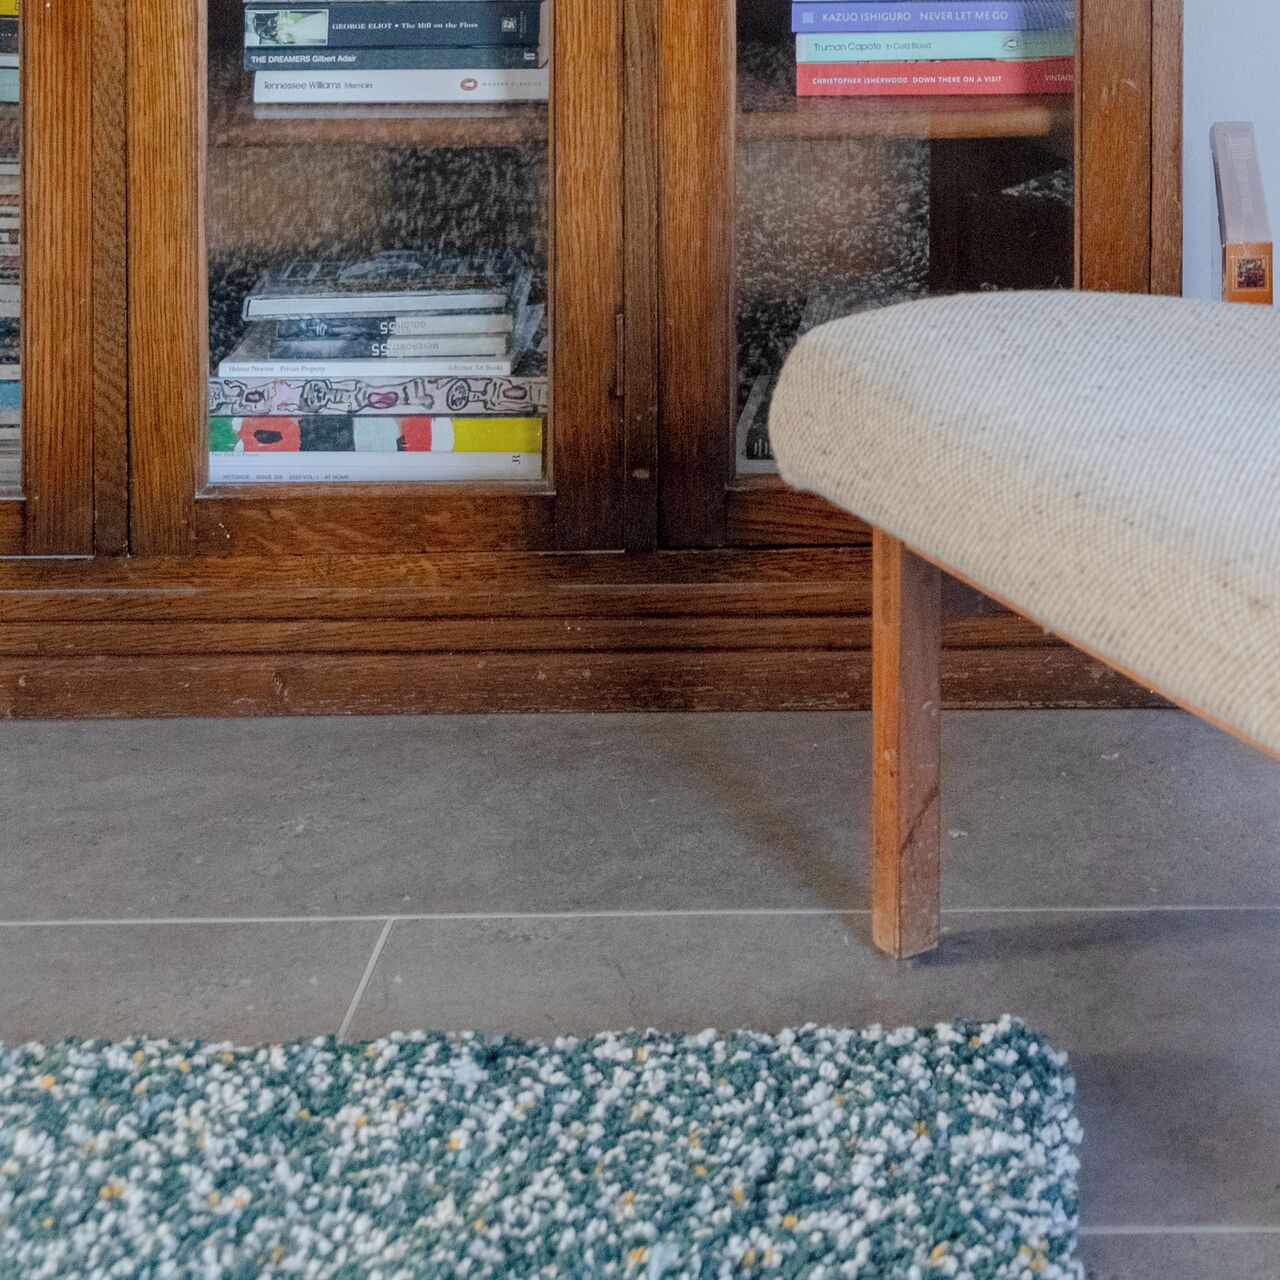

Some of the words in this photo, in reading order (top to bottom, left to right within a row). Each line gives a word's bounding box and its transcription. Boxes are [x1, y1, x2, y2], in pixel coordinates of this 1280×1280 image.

[822, 12, 858, 22] KAZUO
[861, 12, 912, 22] ISHIGURO
[920, 12, 953, 21] NEVER
[955, 12, 972, 20] LET
[974, 11, 991, 20] ME
[992, 10, 1009, 20] GO
[814, 42, 847, 52] Truman
[848, 42, 882, 52] Capote
[894, 42, 911, 50] Cold
[912, 42, 932, 50] Blood
[251, 56, 267, 64] THE
[912, 76, 936, 84] DOWN
[264, 82, 307, 90] Tennessee
[309, 81, 341, 90] Williams
